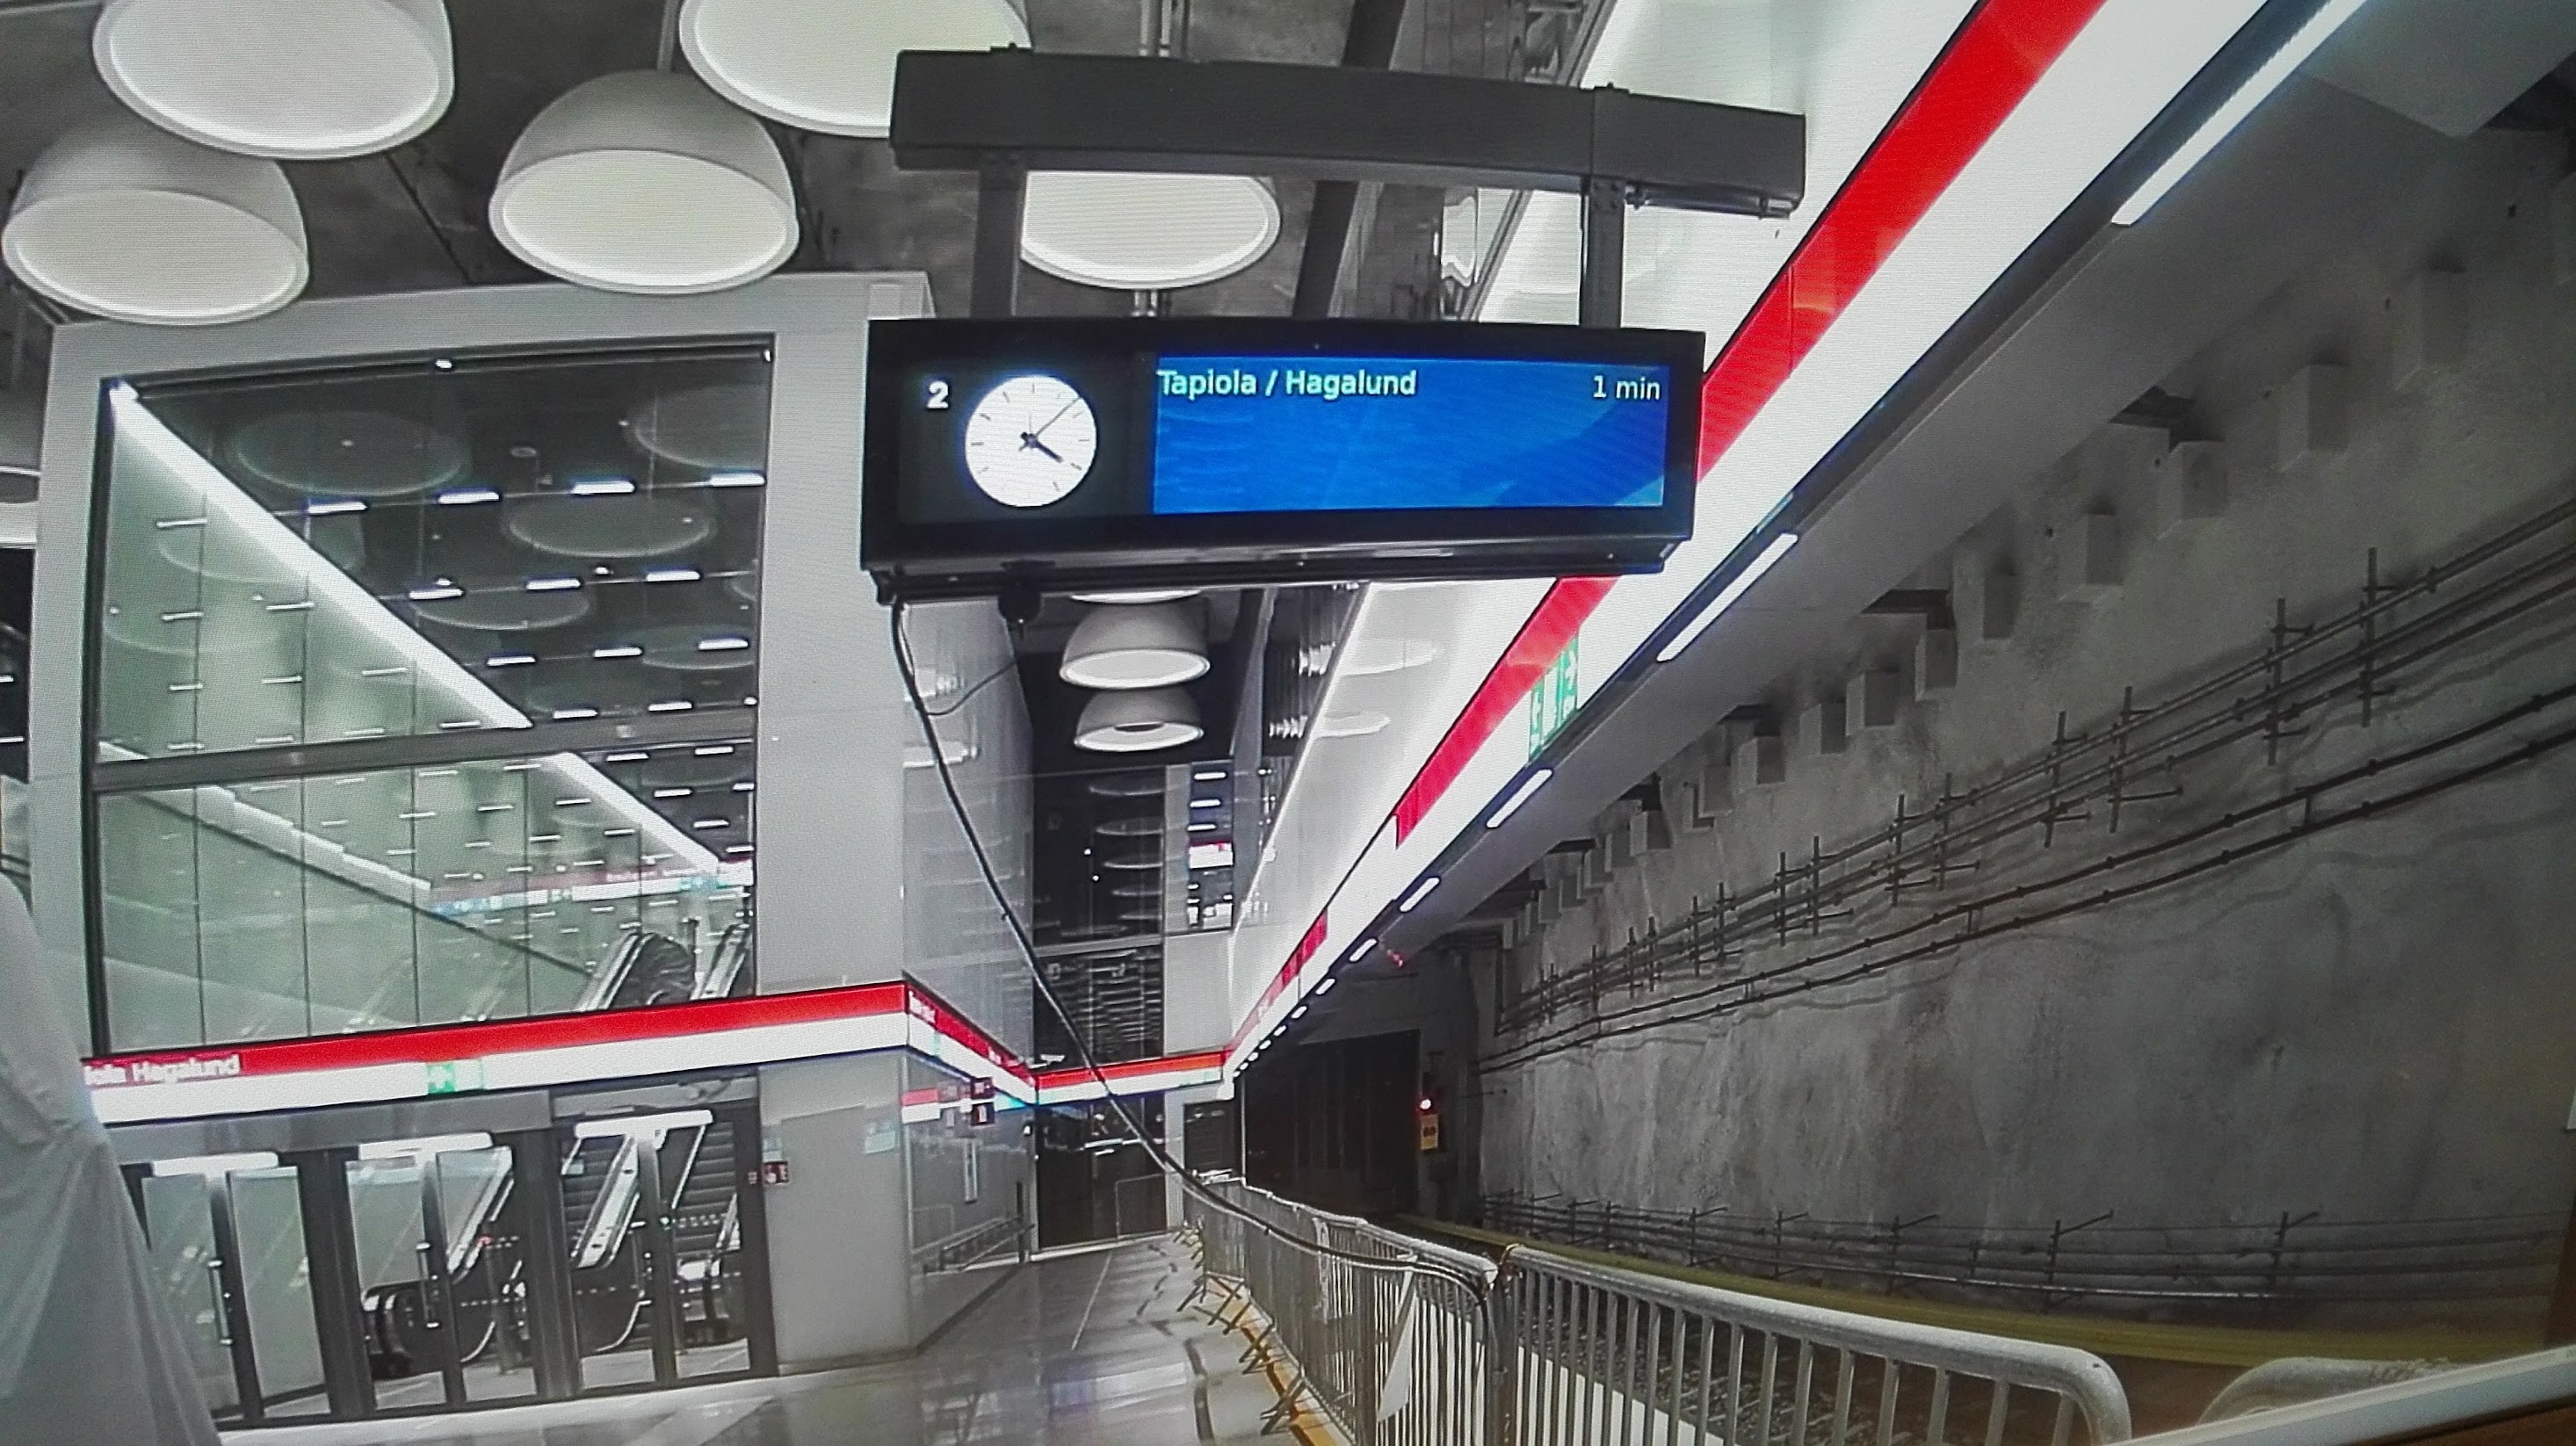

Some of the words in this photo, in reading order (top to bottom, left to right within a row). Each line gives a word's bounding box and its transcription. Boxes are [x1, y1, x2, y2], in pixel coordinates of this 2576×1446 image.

[926, 380, 950, 410] 2
[1156, 368, 1257, 401] Tapiola
[1264, 369, 1279, 396] /
[1285, 369, 1417, 401] Hagalund
[1593, 375, 1607, 398] 1
[1616, 376, 1661, 401] min
[133, 1053, 240, 1084] Hagalund
